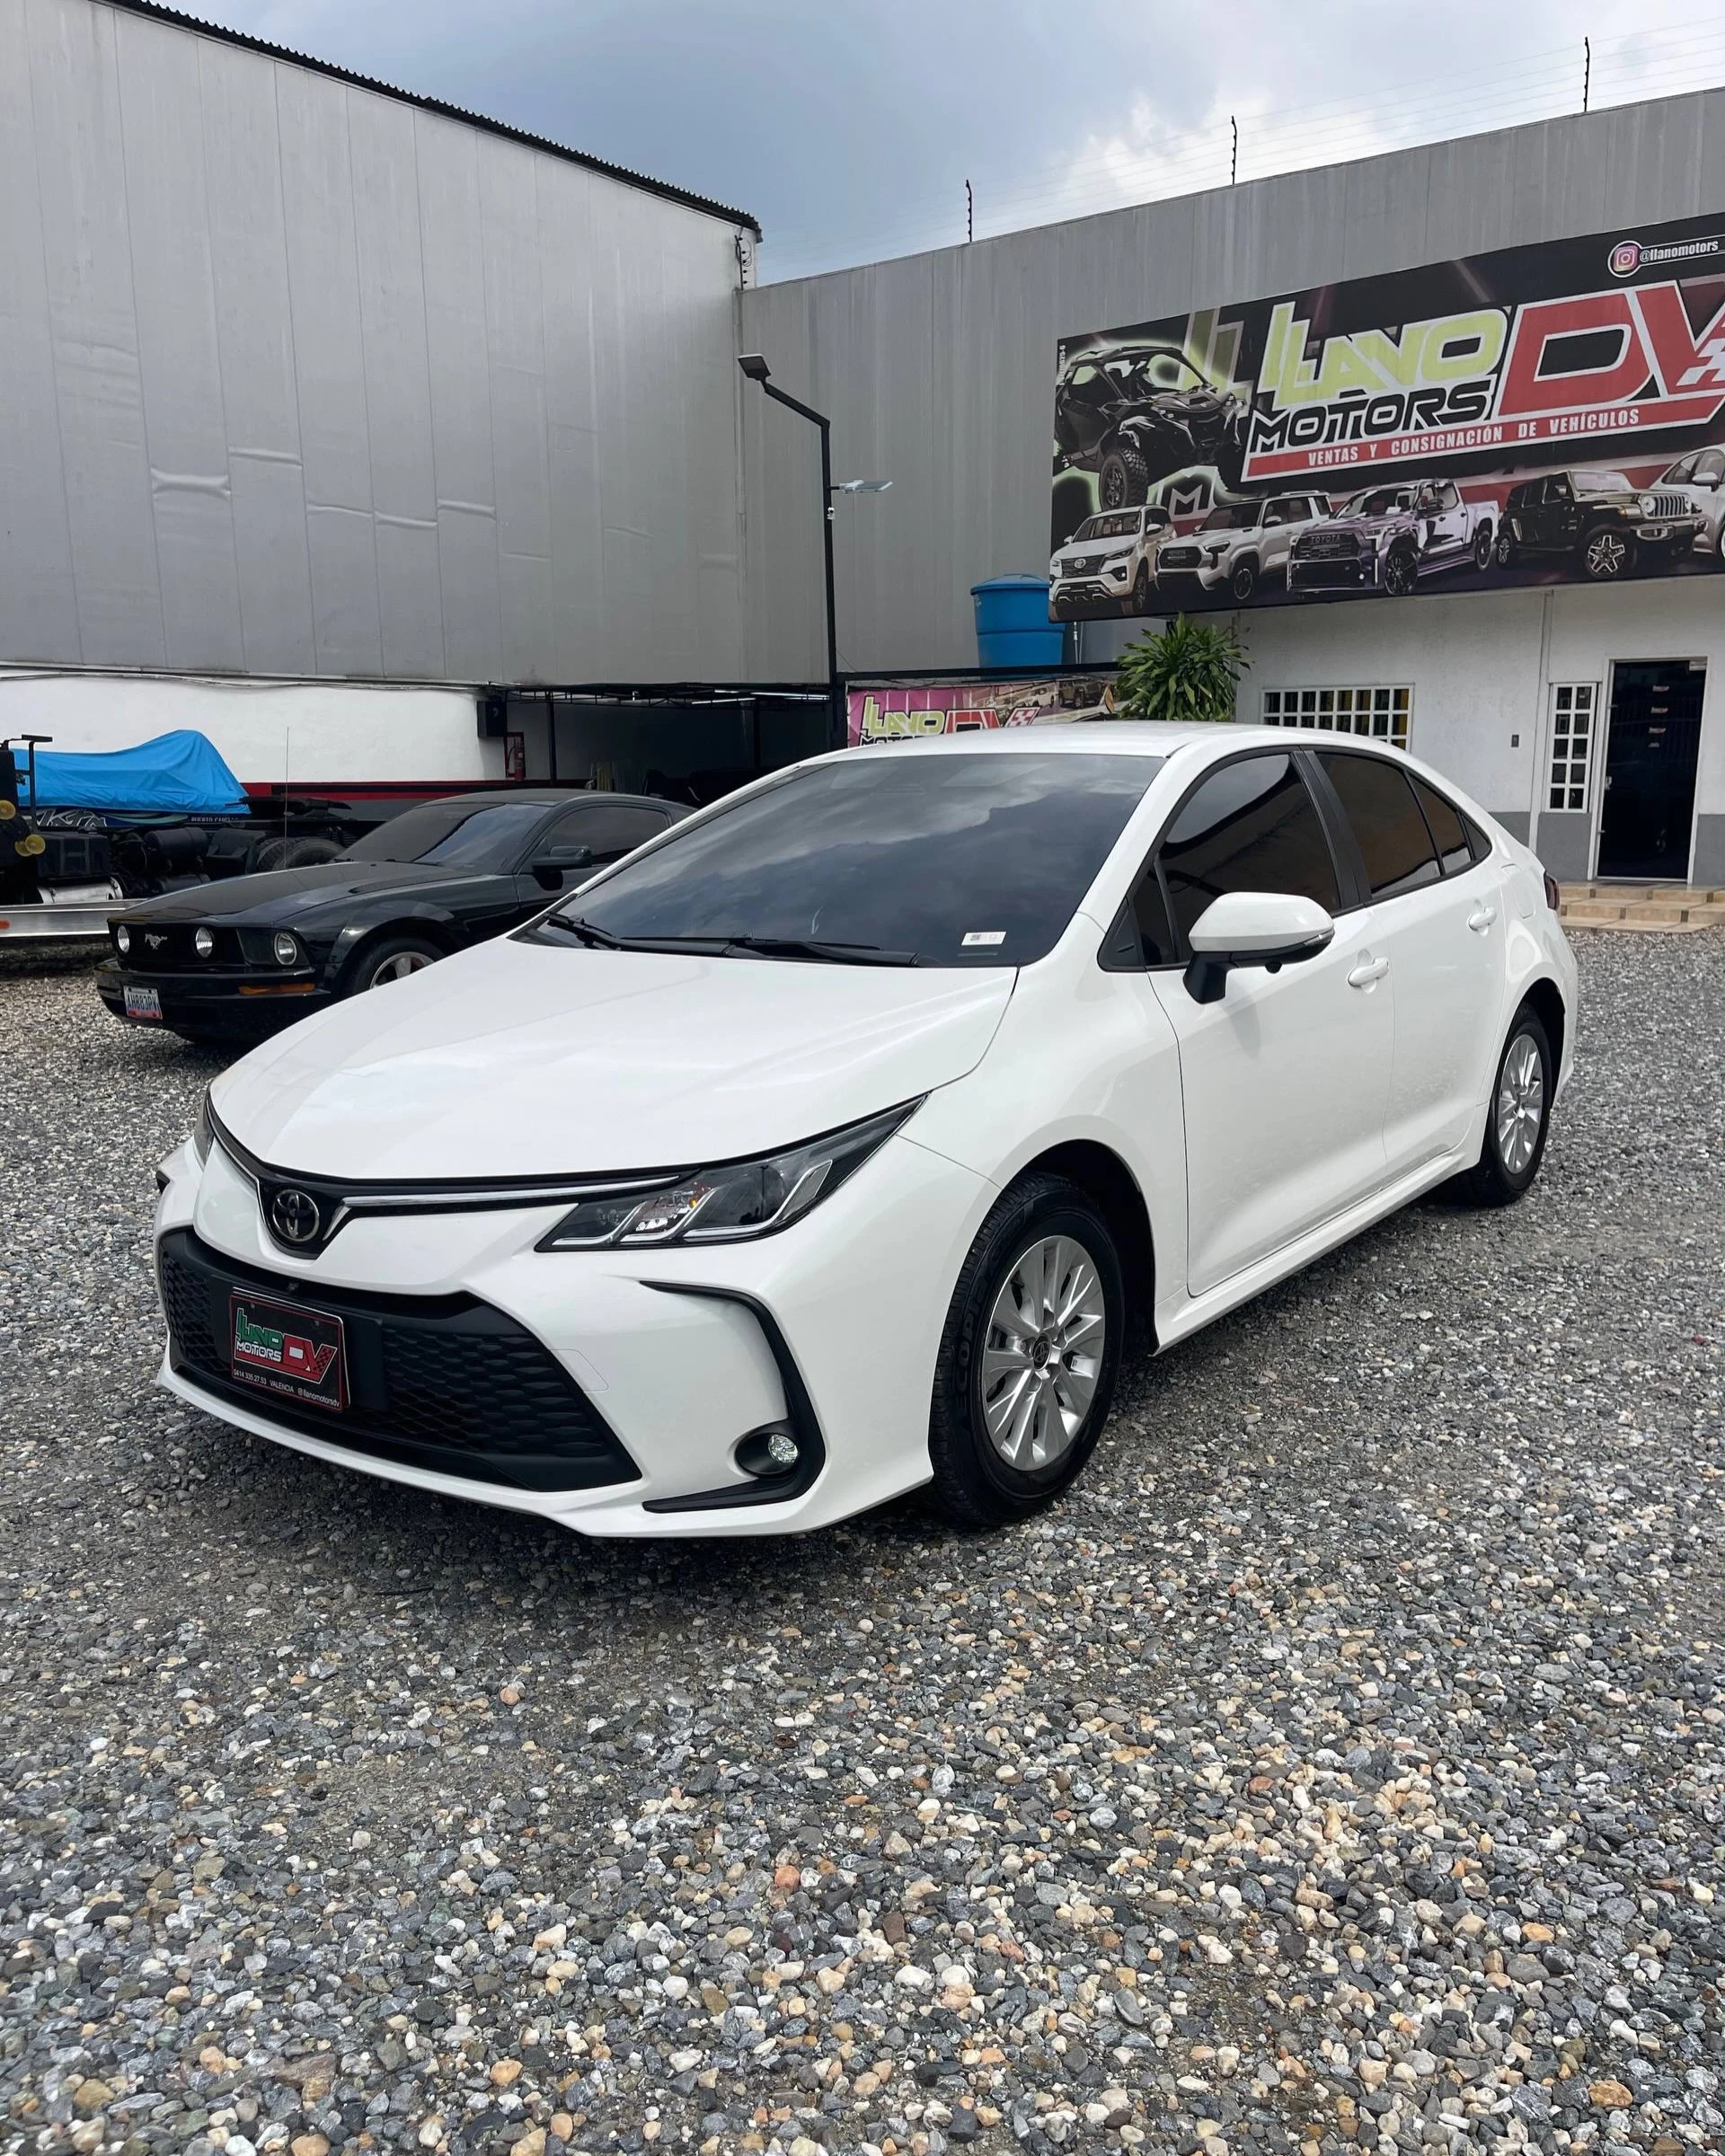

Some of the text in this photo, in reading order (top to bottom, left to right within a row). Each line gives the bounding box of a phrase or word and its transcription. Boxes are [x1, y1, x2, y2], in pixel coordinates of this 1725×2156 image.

[1258, 302, 1509, 407] LLANO
[1248, 379, 1491, 454] MOTORS
[1308, 409, 1640, 466] VENTAS Y CONSIGNACIÓN DE VEHÍCULOS
[862, 695, 945, 736] LLANO
[235, 1307, 284, 1350] LLANO
[236, 1340, 282, 1363] MOTORS
[234, 1368, 244, 1378] 0414
[244, 1372, 253, 1381] 335
[253, 1374, 260, 1383] 27
[270, 1379, 295, 1392] VALENCIA
